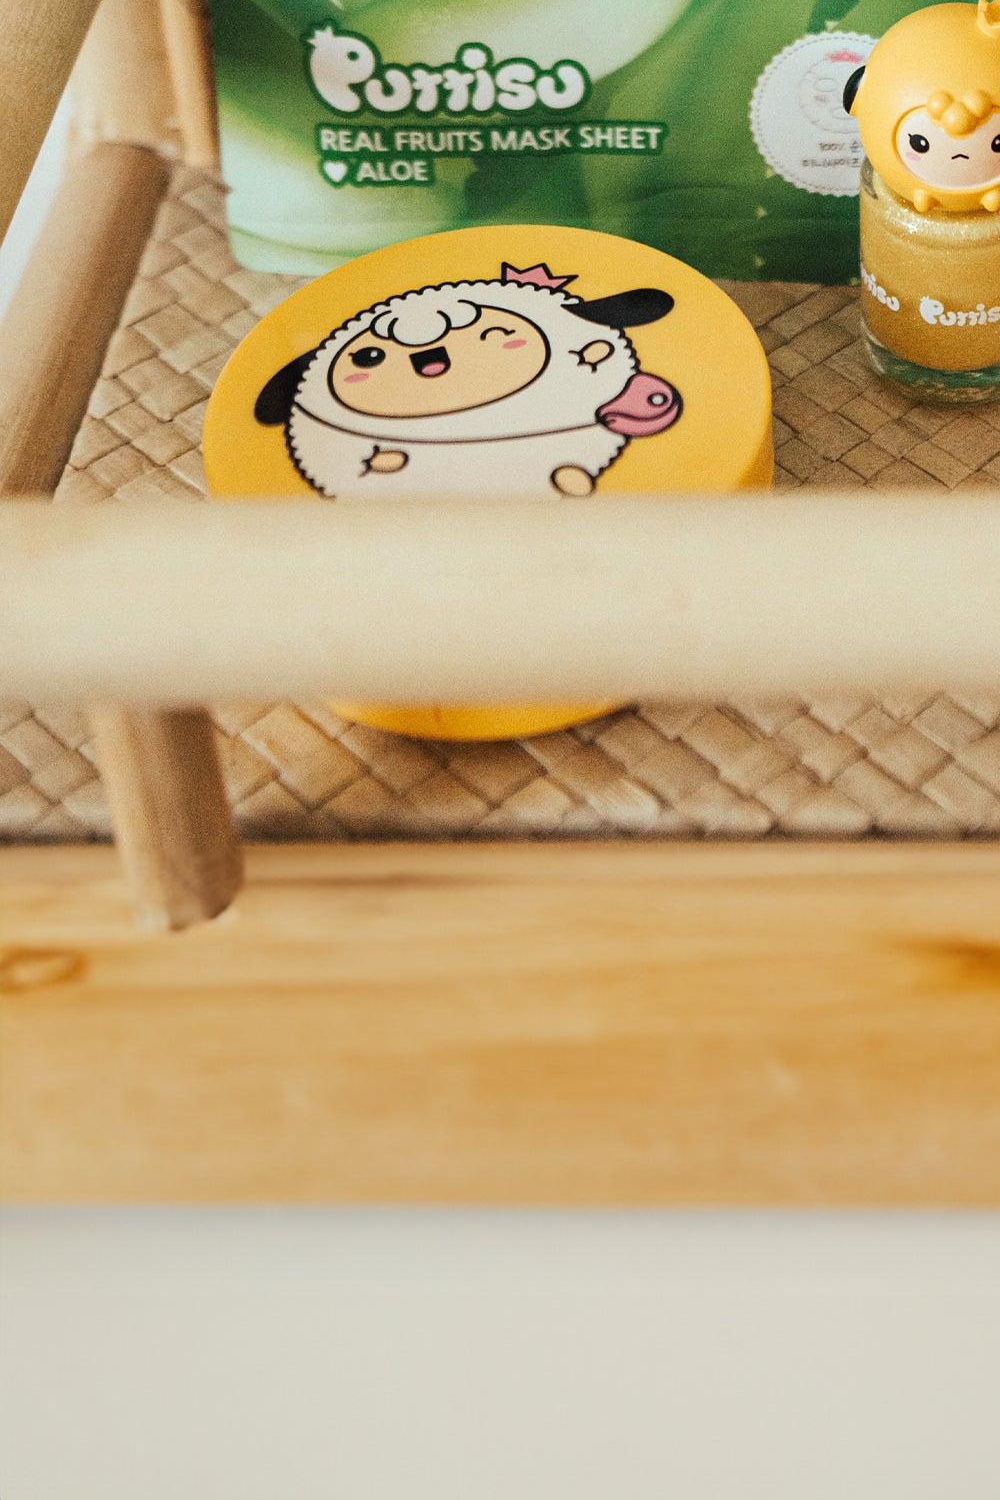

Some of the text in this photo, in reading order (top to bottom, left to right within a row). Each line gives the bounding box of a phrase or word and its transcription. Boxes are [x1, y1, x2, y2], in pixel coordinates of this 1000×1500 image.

[319, 125, 663, 153] REAL FRUITS MASK SHEET
[355, 160, 429, 182] ALOE
